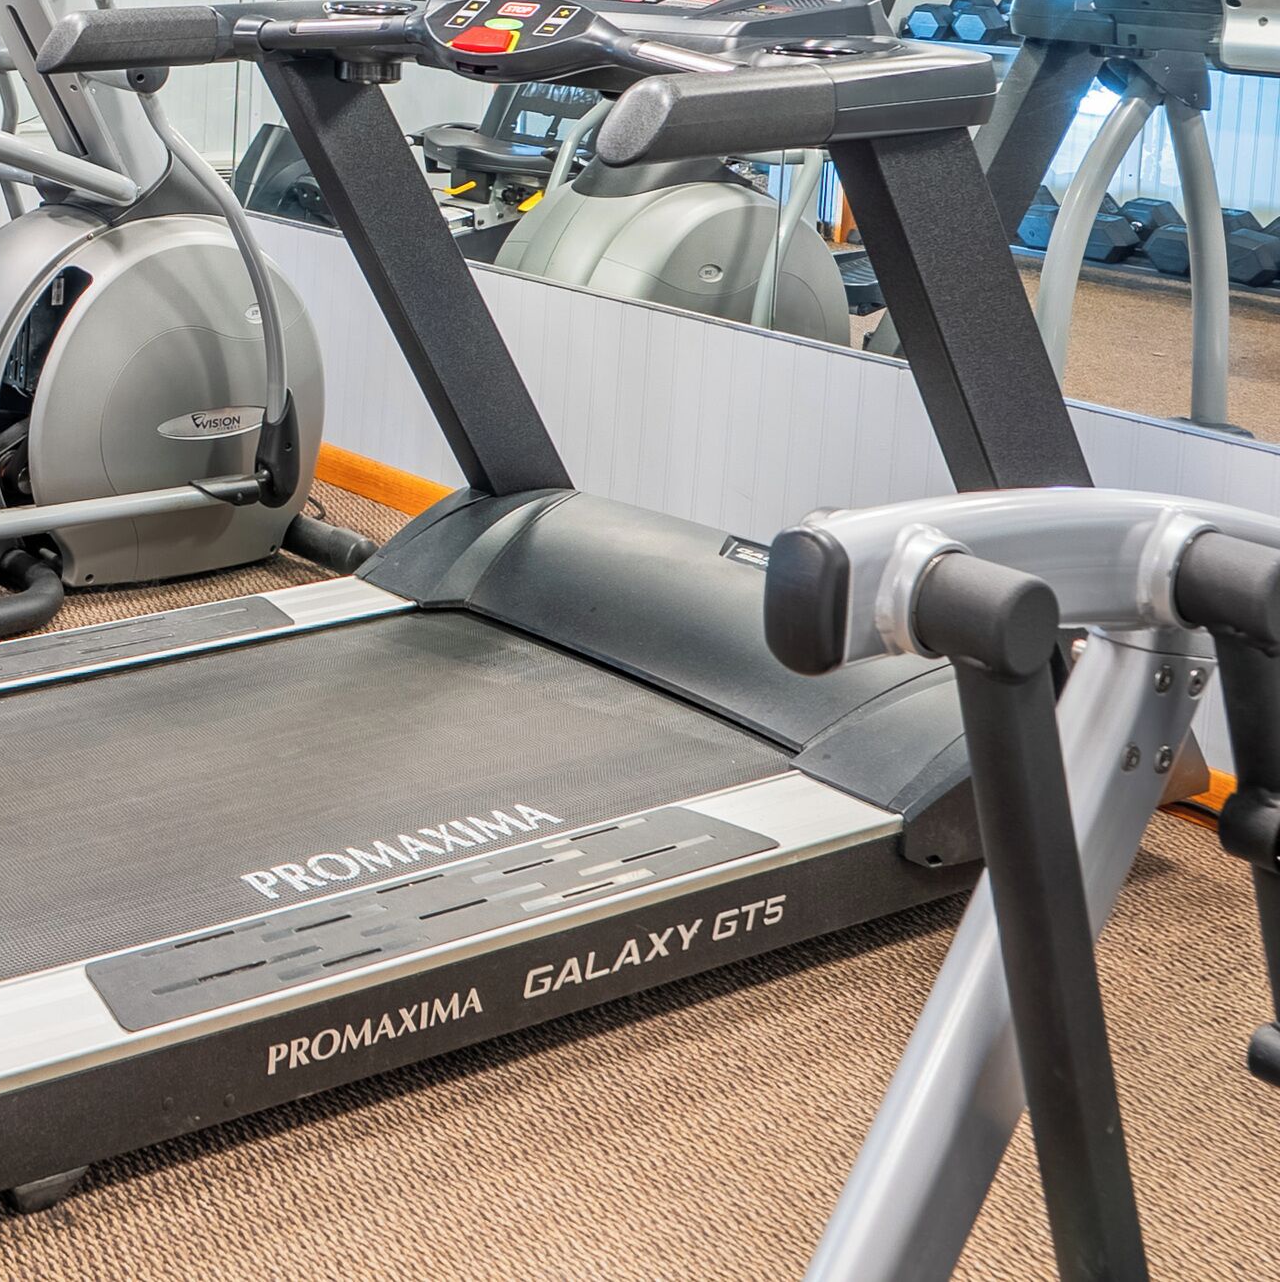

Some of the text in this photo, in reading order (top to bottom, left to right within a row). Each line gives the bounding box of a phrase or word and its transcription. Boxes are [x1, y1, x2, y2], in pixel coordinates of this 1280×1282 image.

[504, 5, 534, 14] STOP
[201, 415, 241, 429] VISION
[240, 803, 564, 899] PROMAXIMA
[267, 894, 787, 1076] PROMAXIMA GALAXY GT5
